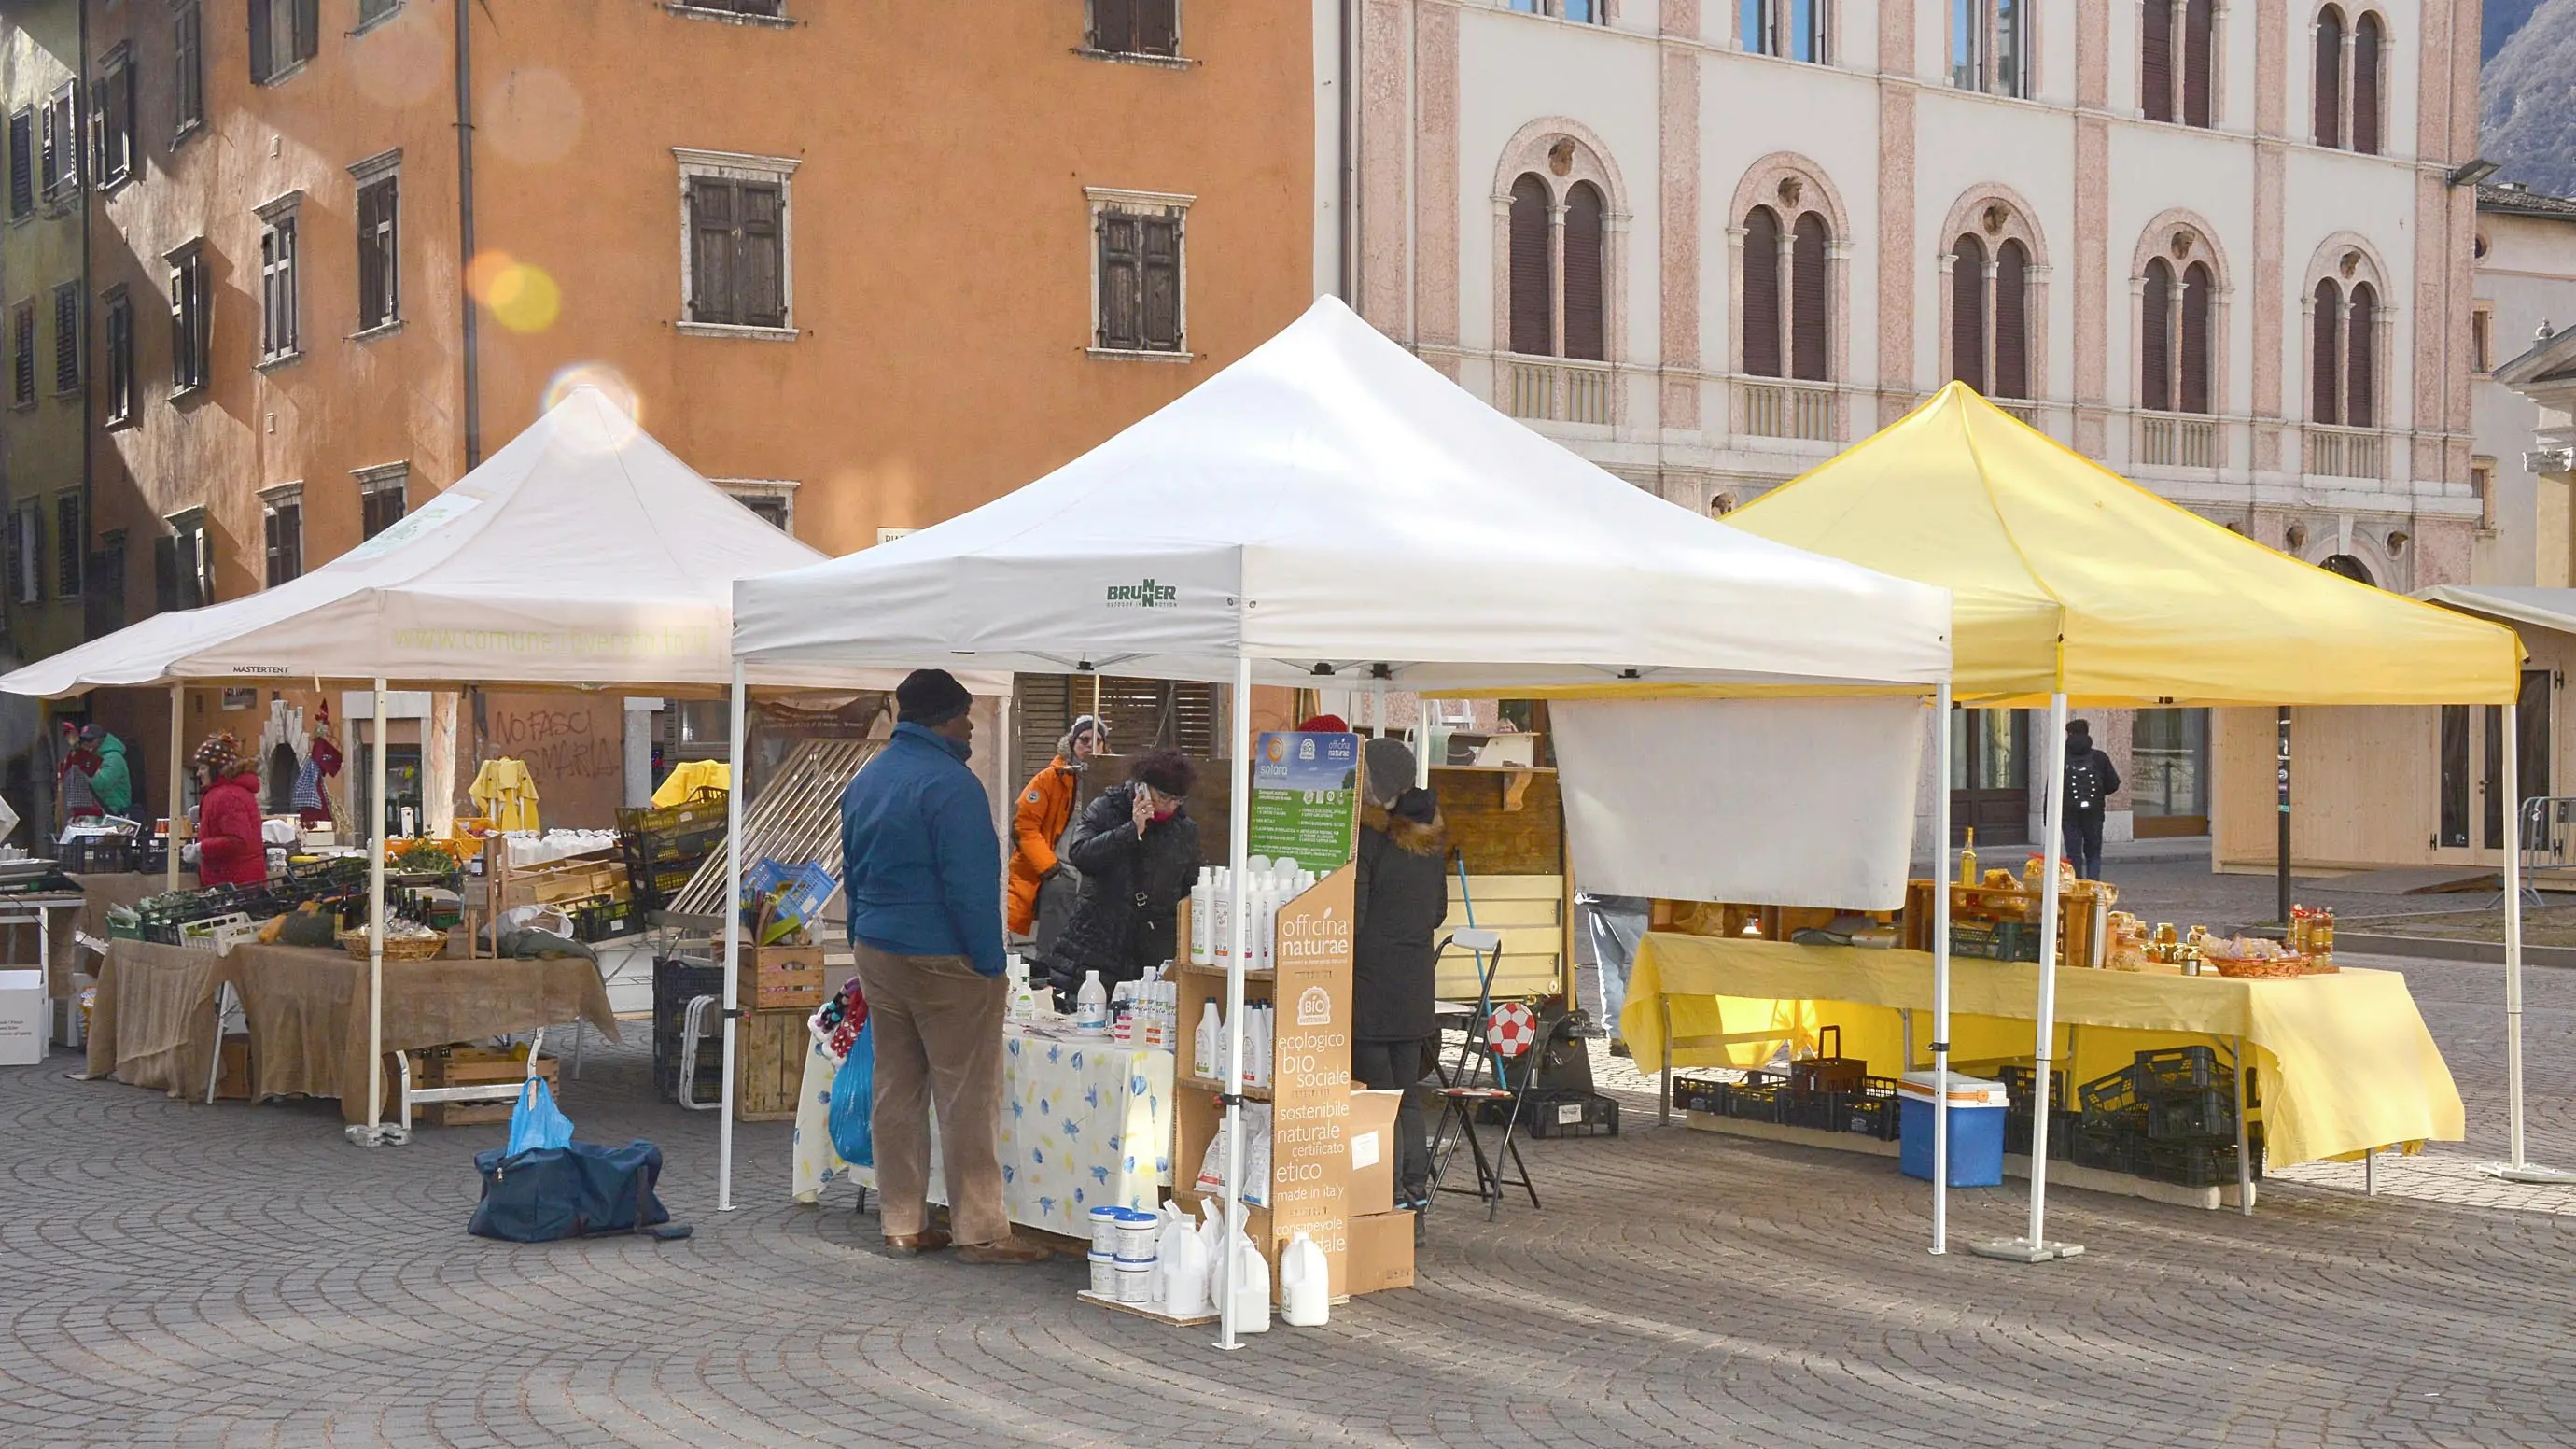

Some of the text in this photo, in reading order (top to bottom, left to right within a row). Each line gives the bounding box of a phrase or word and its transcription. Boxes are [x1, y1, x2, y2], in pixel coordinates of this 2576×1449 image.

[1107, 579, 1176, 607] BRUNNER
[495, 710, 525, 745] NO
[1260, 763, 1288, 776] solara
[1282, 907, 1348, 936] officina
[1282, 938, 1348, 956] naturae
[1278, 1031, 1345, 1052] ecologico
[1283, 1048, 1315, 1074] bio
[1297, 1066, 1350, 1088] sociale
[1281, 1100, 1350, 1120] sostenibile
[1277, 1120, 1340, 1143] naturale
[1292, 1142, 1345, 1157] certificato
[1276, 1159, 1322, 1183] etico
[1277, 1183, 1344, 1202] made in italy
[1276, 1216, 1343, 1236] consapevole
